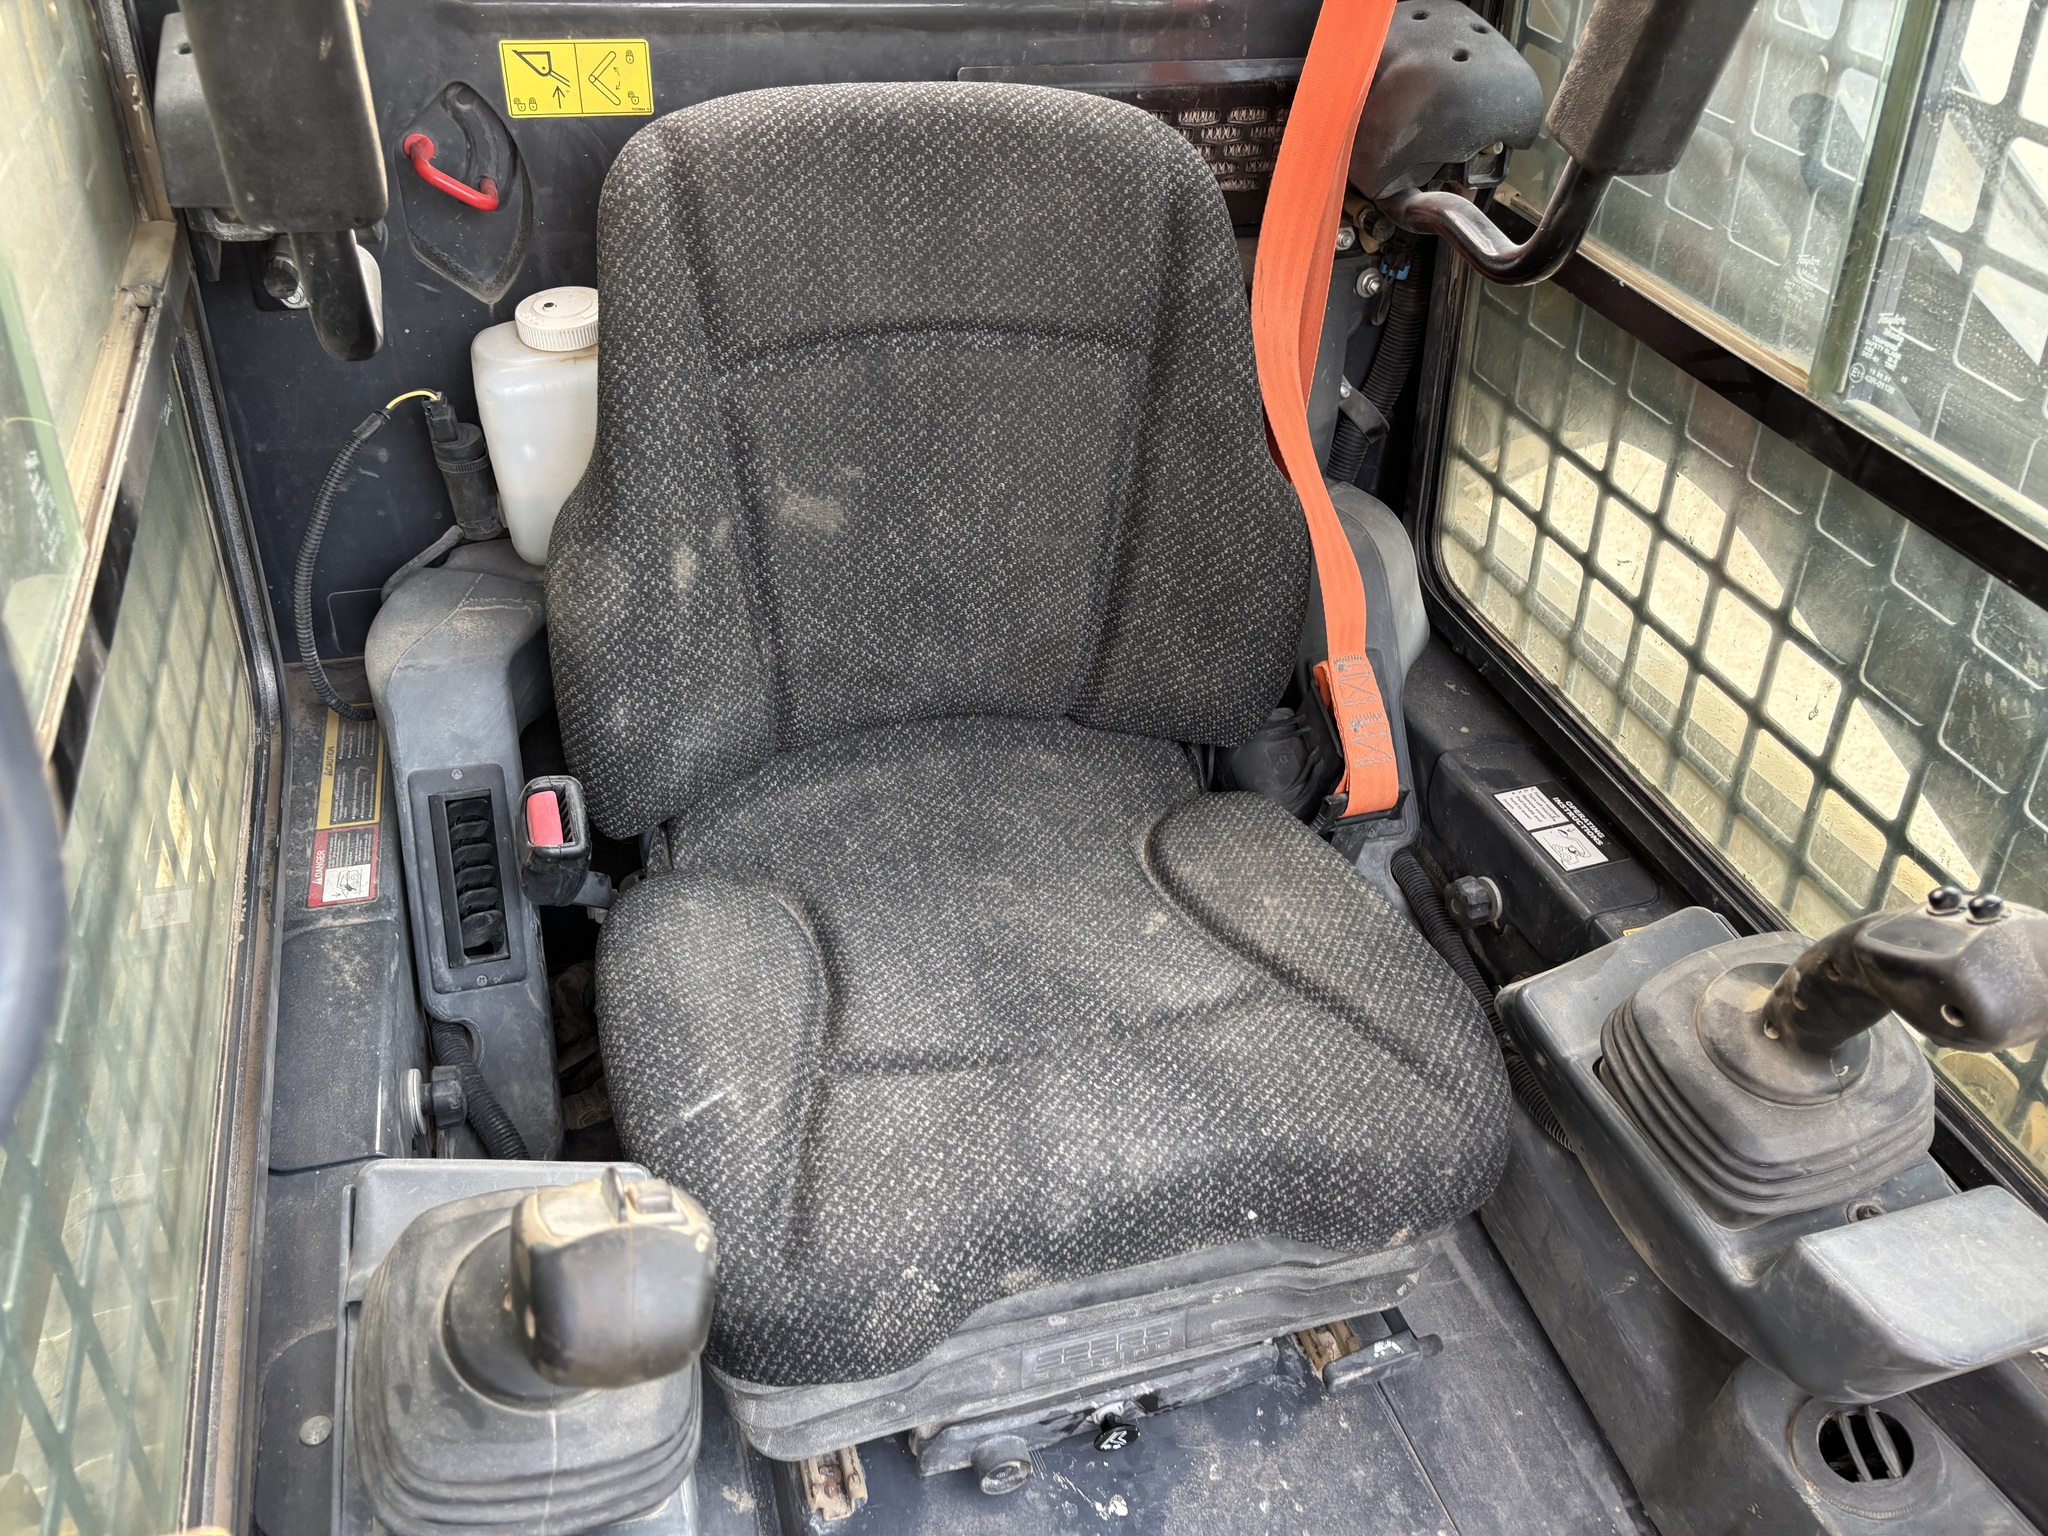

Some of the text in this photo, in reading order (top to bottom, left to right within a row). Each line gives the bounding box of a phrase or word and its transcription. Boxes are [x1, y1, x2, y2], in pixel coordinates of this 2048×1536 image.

[1796, 255, 1820, 267] Taylor
[1878, 313, 1906, 326] Taylor
[324, 745, 335, 771] CAUTION
[1552, 797, 1604, 846] INSTRUCTIONS
[1565, 800, 1606, 838] OPERATING
[314, 849, 325, 877] DANGER
